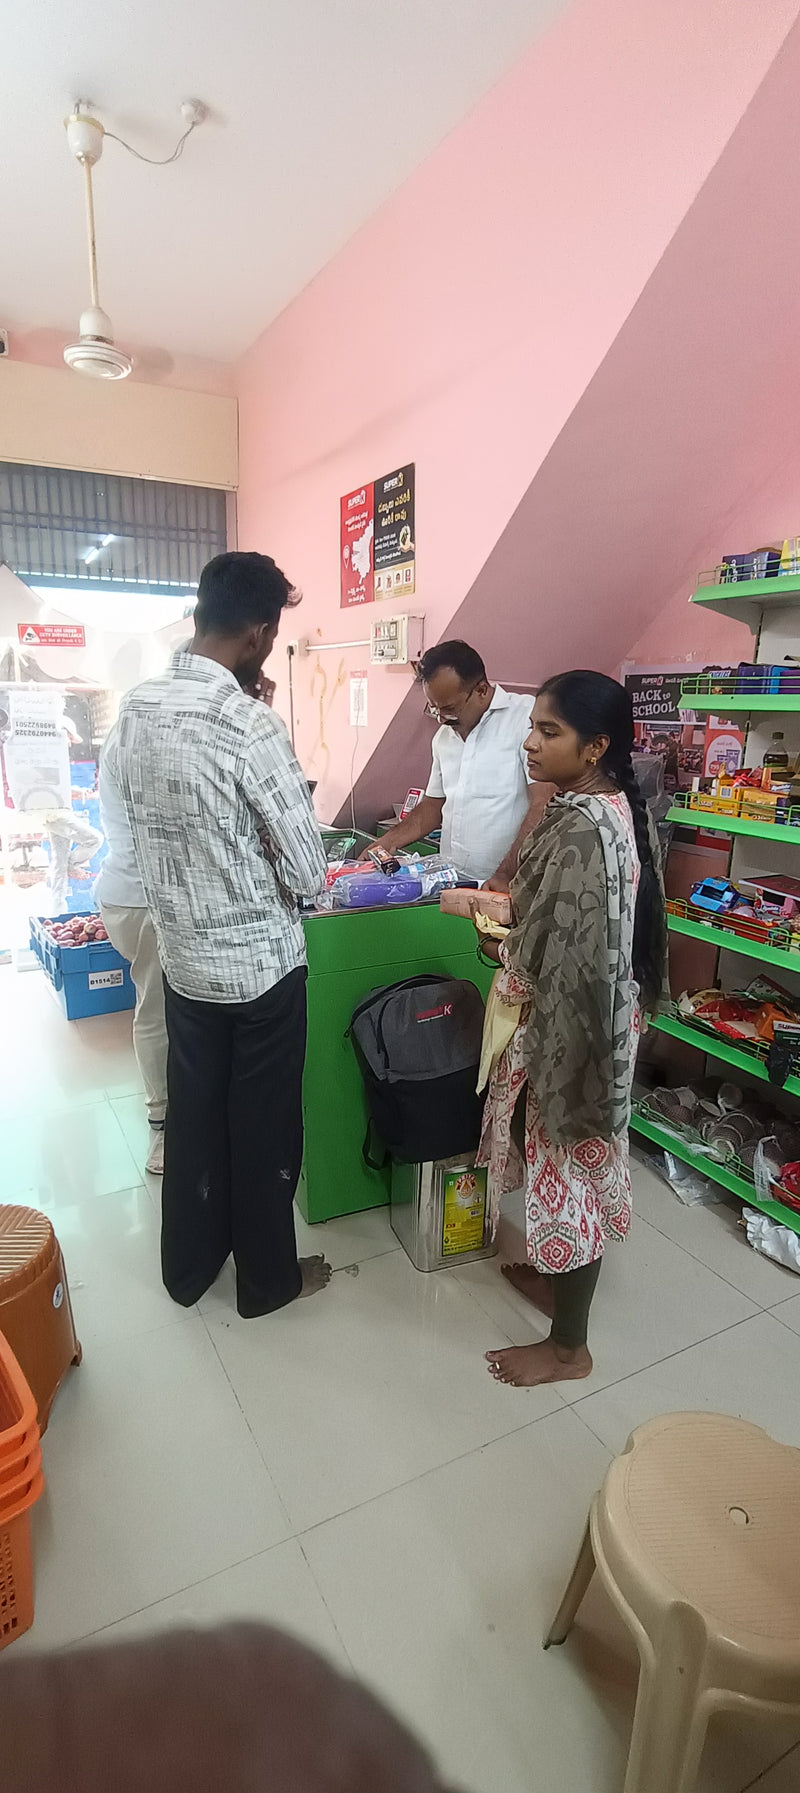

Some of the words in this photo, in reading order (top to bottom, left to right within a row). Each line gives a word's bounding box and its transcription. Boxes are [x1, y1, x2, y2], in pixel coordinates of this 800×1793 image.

[632, 689, 662, 703] BACK
[662, 692, 671, 700] to
[632, 701, 675, 717] SCHOOL
